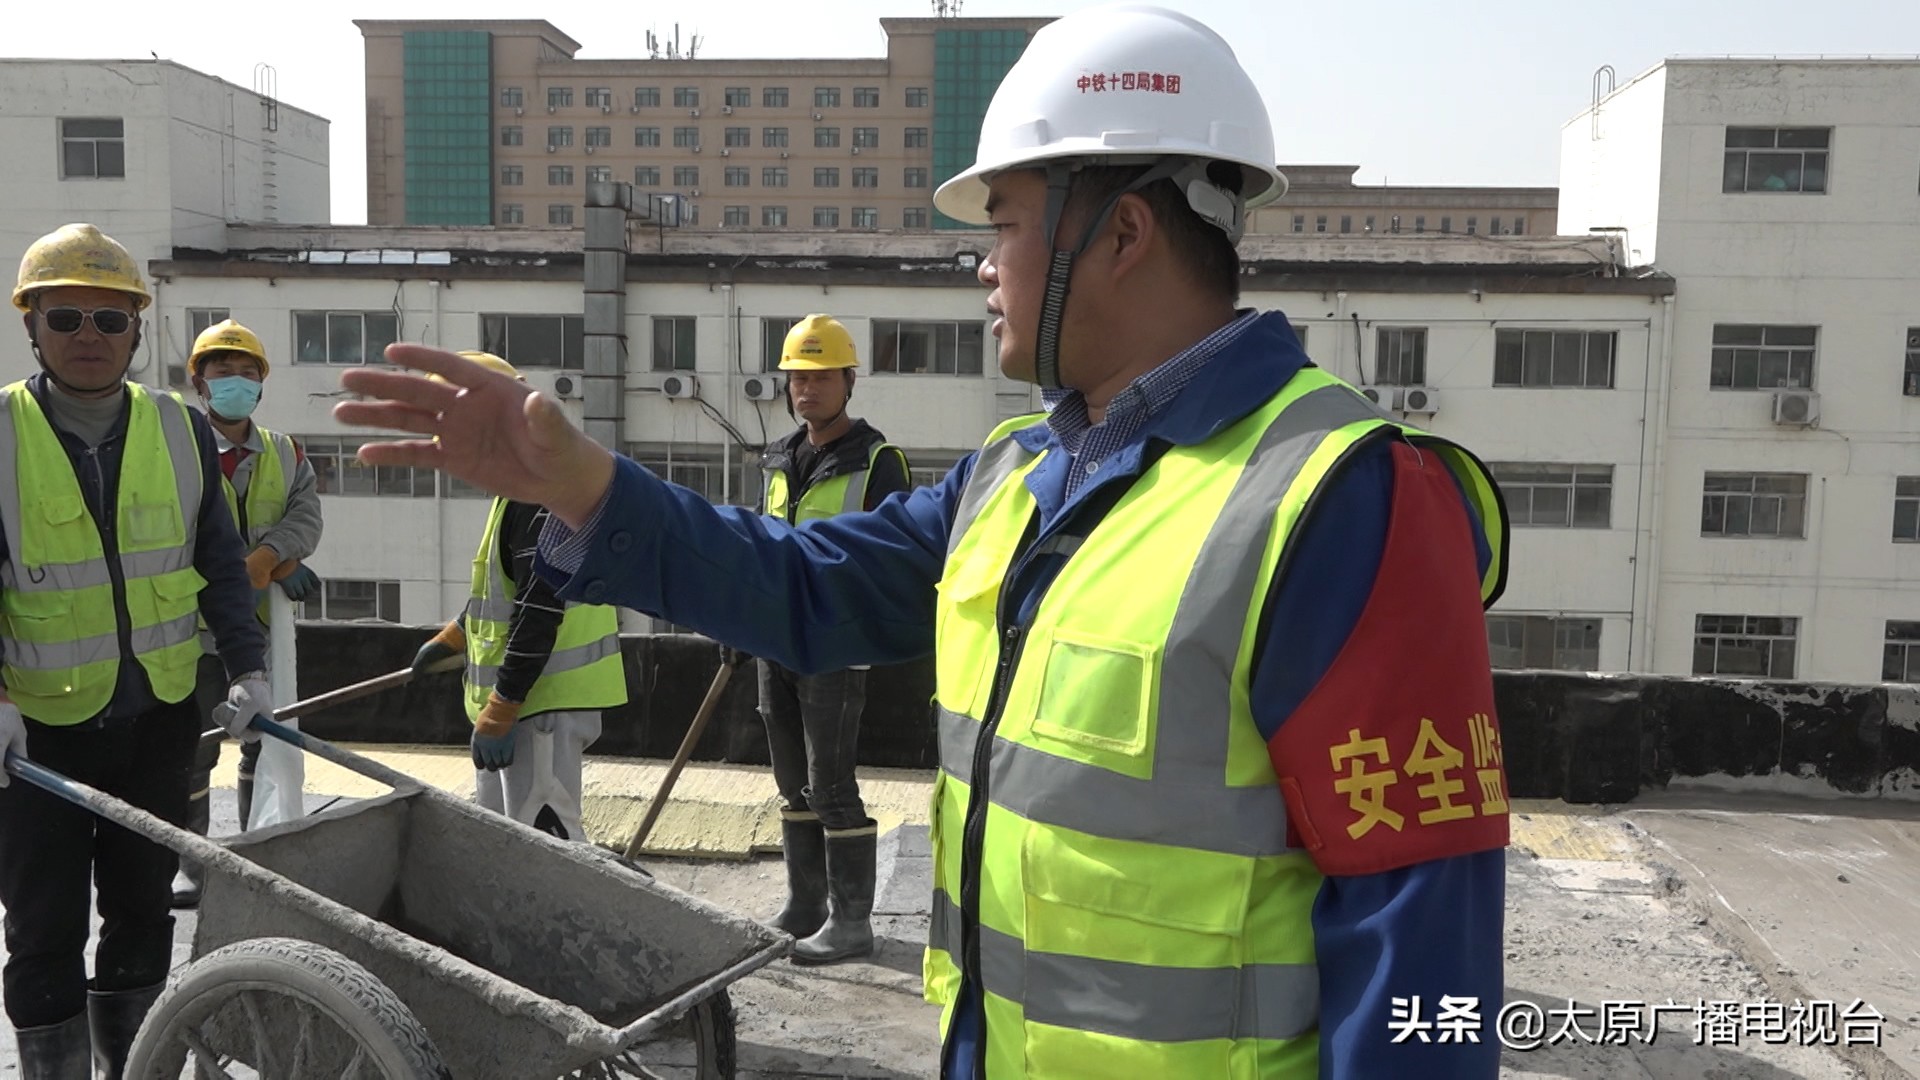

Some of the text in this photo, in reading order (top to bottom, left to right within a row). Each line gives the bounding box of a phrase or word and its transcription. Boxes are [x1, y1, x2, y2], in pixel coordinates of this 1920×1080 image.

[1077, 71, 1181, 94] 中铁十四局集团
